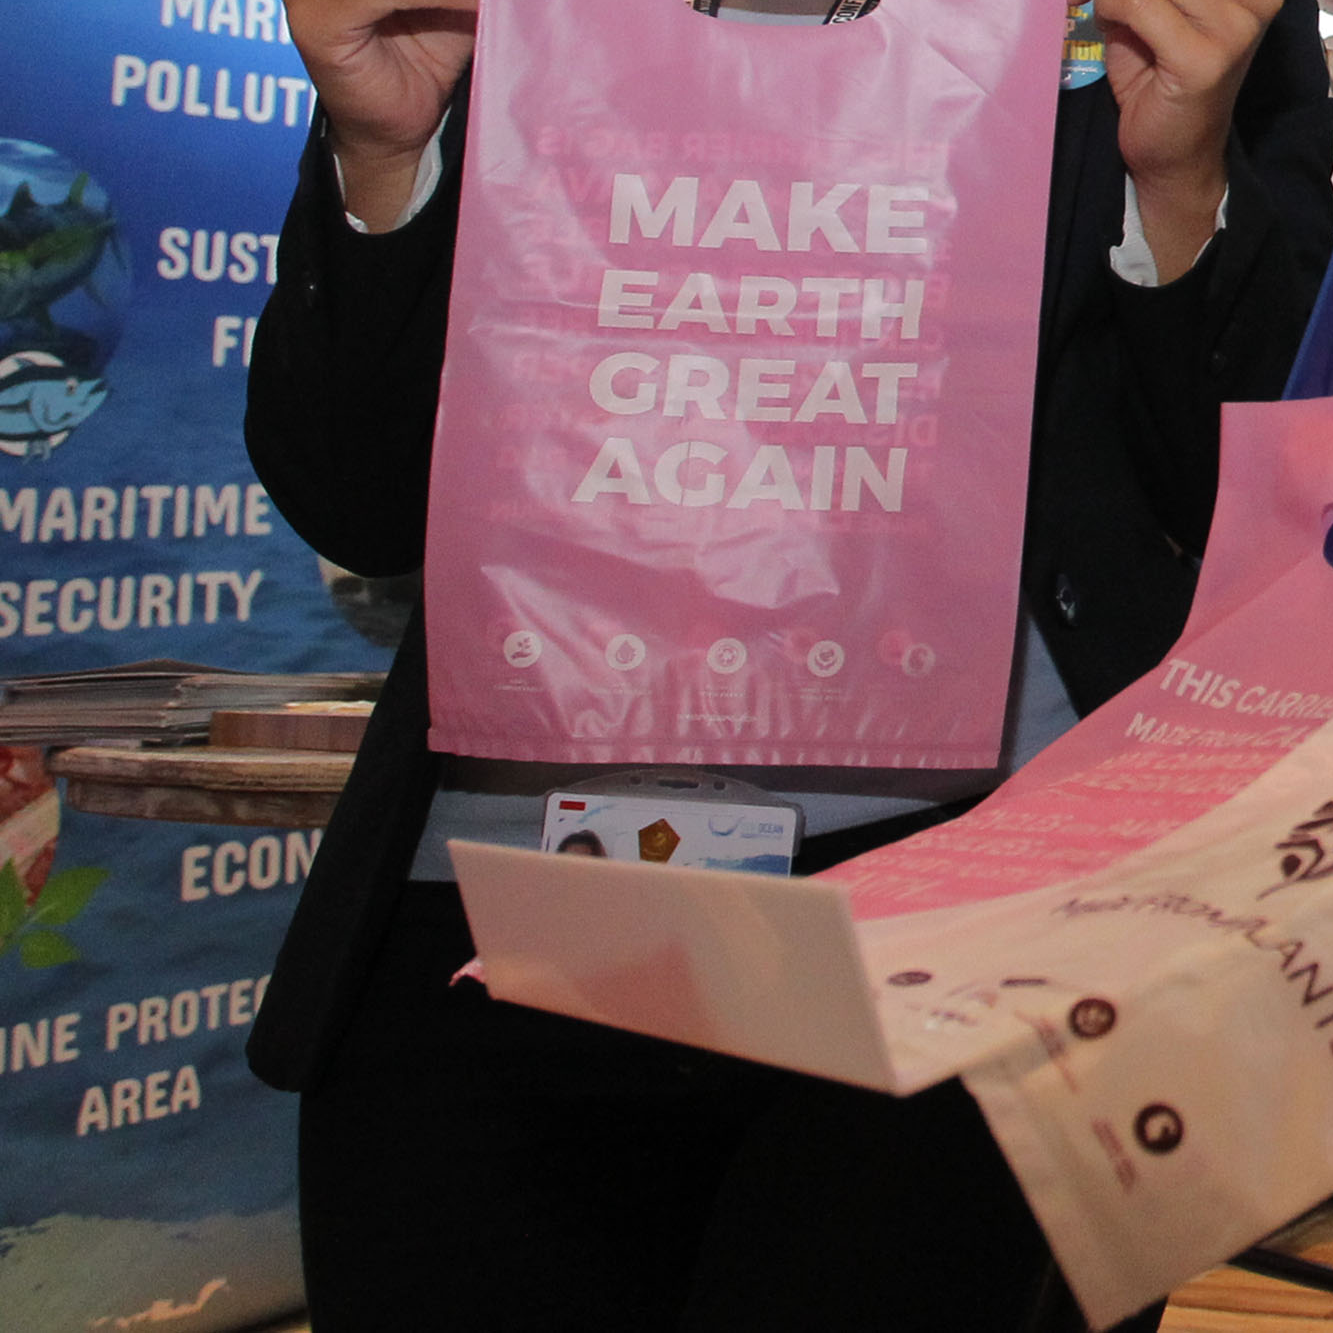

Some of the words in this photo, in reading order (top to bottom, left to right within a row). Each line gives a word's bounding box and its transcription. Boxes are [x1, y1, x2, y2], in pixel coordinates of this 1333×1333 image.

[608, 172, 930, 254] MAKE
[597, 268, 925, 340] EARTH
[588, 351, 918, 425] GREAT
[570, 437, 909, 513] AGAIN
[0, 485, 273, 544] MARITIME
[0, 570, 262, 638] SECURITY
[1159, 658, 1241, 709] THIS
[180, 828, 323, 903] ECON
[77, 1064, 200, 1137] AREA
